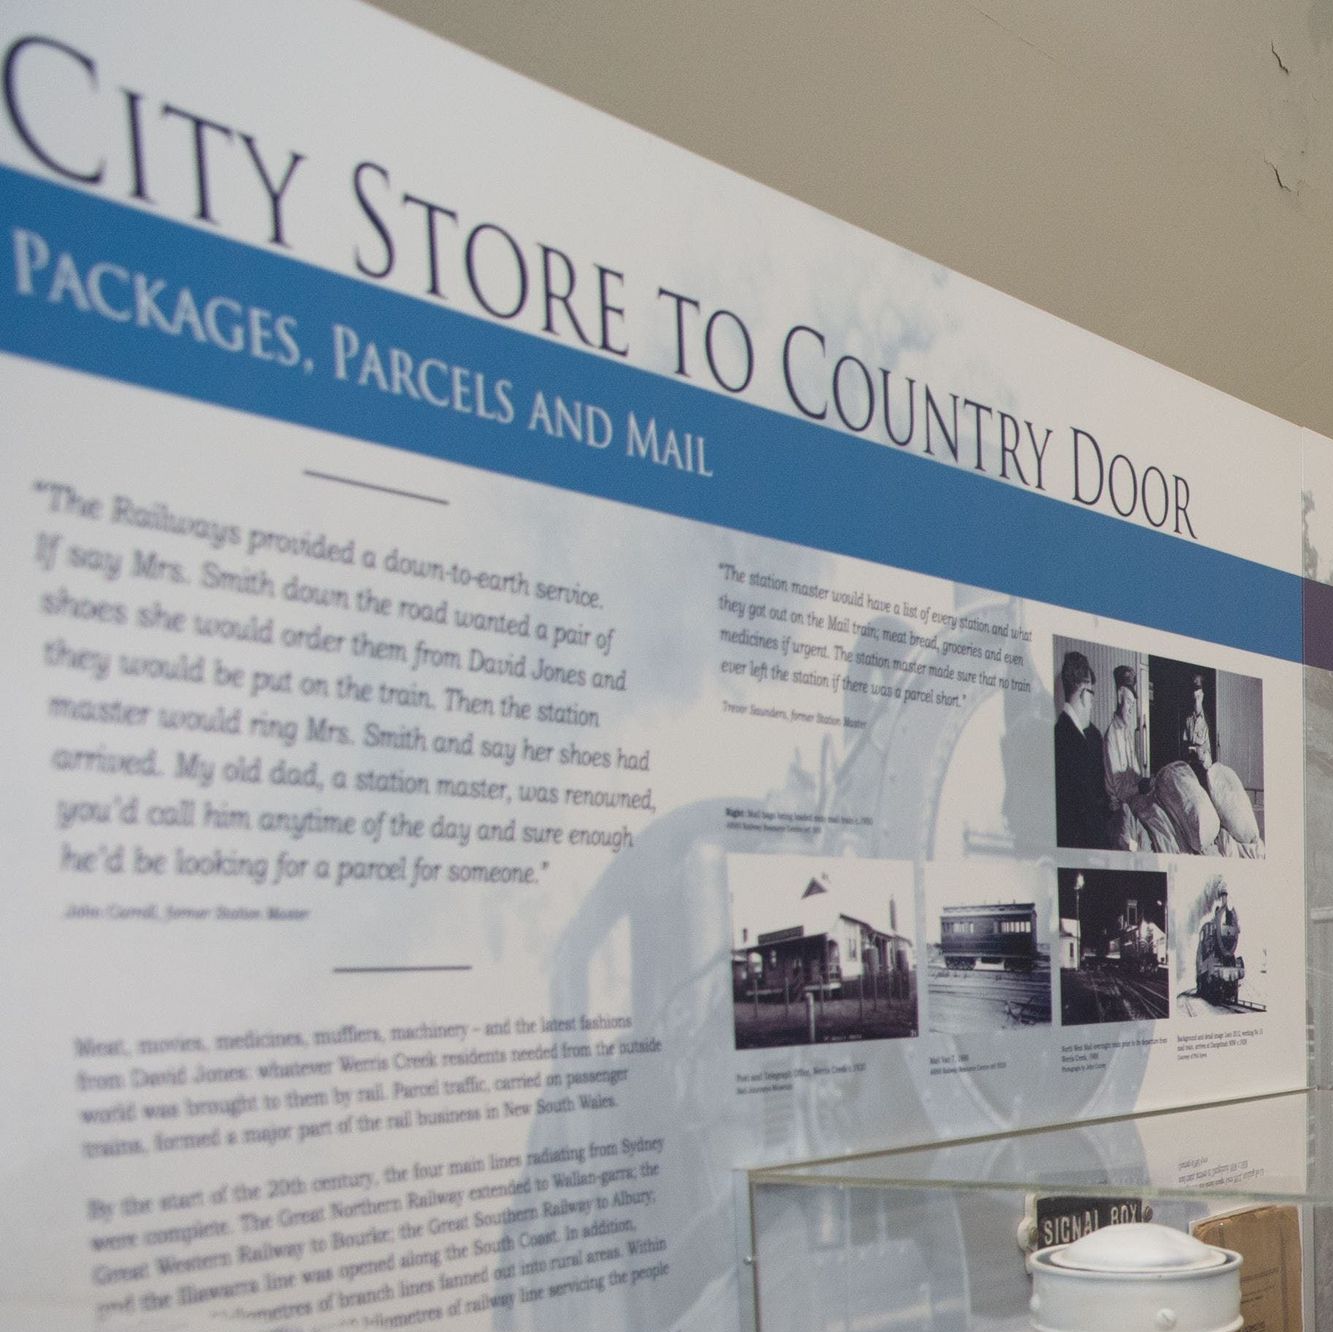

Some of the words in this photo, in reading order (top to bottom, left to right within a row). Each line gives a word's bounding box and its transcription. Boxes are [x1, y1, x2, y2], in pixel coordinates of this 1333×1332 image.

[2, 35, 307, 249] CITY
[351, 160, 629, 359] STORE
[657, 286, 756, 395] TO
[782, 325, 1053, 491] COUNTRY
[1071, 427, 1198, 539] DOOR
[12, 228, 313, 375] PACKAGES,
[331, 323, 516, 425] PARCELS
[527, 392, 613, 450] AND
[626, 411, 714, 479] MAIL
[113, 495, 241, 550] Railways
[248, 529, 354, 565] provided
[384, 547, 529, 596] down-to-earth
[36, 531, 62, 571] If
[69, 546, 121, 581] say
[202, 560, 274, 597] Smith
[282, 575, 349, 609] down
[356, 588, 391, 616] the
[399, 600, 448, 624] road
[455, 609, 530, 637] wanted
[552, 625, 591, 648] pair
[595, 627, 615, 656] of
[749, 572, 788, 591] station
[790, 581, 829, 599] master
[832, 590, 864, 607] would
[867, 593, 891, 613] have
[903, 601, 918, 618] list
[919, 605, 931, 624] of
[931, 611, 959, 630] every
[959, 615, 990, 633] station
[992, 623, 1009, 637] and
[1011, 626, 1033, 642] what
[42, 588, 127, 624] shoes
[138, 602, 184, 632] she
[194, 615, 273, 644] would
[281, 625, 345, 652] order
[352, 632, 406, 662] them
[413, 639, 461, 671] from
[468, 647, 526, 678] David
[531, 657, 586, 686] Jones
[591, 669, 626, 691] and
[718, 594, 745, 618] they
[749, 603, 766, 620] got
[769, 607, 787, 621] out
[790, 611, 804, 624] on
[807, 611, 824, 628] the
[827, 614, 849, 633] Mail
[882, 629, 906, 644] meat
[942, 641, 982, 658] groceries
[984, 647, 1002, 662] and
[1004, 653, 1023, 666] even
[719, 628, 778, 650] medicines
[781, 635, 791, 656] if
[833, 644, 853, 662] The
[855, 651, 890, 668] station
[893, 658, 927, 674] master
[928, 664, 954, 680] made
[957, 670, 977, 683] sure
[979, 671, 997, 687] that
[998, 677, 1009, 689] no
[1011, 678, 1031, 692] train
[44, 639, 109, 680] they
[120, 654, 205, 683] would
[215, 659, 244, 687] be
[251, 670, 292, 696] put
[299, 676, 328, 697] on
[337, 674, 372, 702] the
[445, 686, 494, 715] Then
[500, 694, 531, 720] the
[537, 702, 599, 727] station
[720, 660, 747, 674] ever
[750, 660, 768, 682] left
[770, 664, 789, 681] the
[792, 670, 829, 687] station
[832, 673, 841, 693] if
[842, 675, 868, 693] there
[871, 683, 893, 698] was
[904, 688, 933, 703] parcel
[49, 697, 151, 725] master
[159, 706, 240, 735] would
[250, 717, 298, 747] ring
[363, 721, 427, 751] Smith
[432, 732, 473, 756] and
[481, 739, 516, 766] say
[523, 737, 554, 762] her
[560, 741, 611, 768] shoes
[617, 747, 649, 771] had
[176, 751, 214, 787] My
[223, 755, 261, 784] old
[355, 770, 430, 794] station
[519, 784, 559, 804] was
[146, 799, 195, 827] call
[204, 801, 250, 829] him
[259, 811, 355, 840] anytime
[361, 810, 386, 843] of
[390, 812, 424, 838] the
[430, 814, 470, 847] day
[476, 818, 515, 842] and
[522, 825, 563, 844] sure
[568, 825, 634, 853] enough
[135, 847, 165, 874] be
[177, 848, 268, 885] looking
[274, 851, 309, 884] for
[336, 856, 406, 886] parcel
[411, 855, 442, 888] for
[1044, 1210, 1100, 1245] SIGNAL
